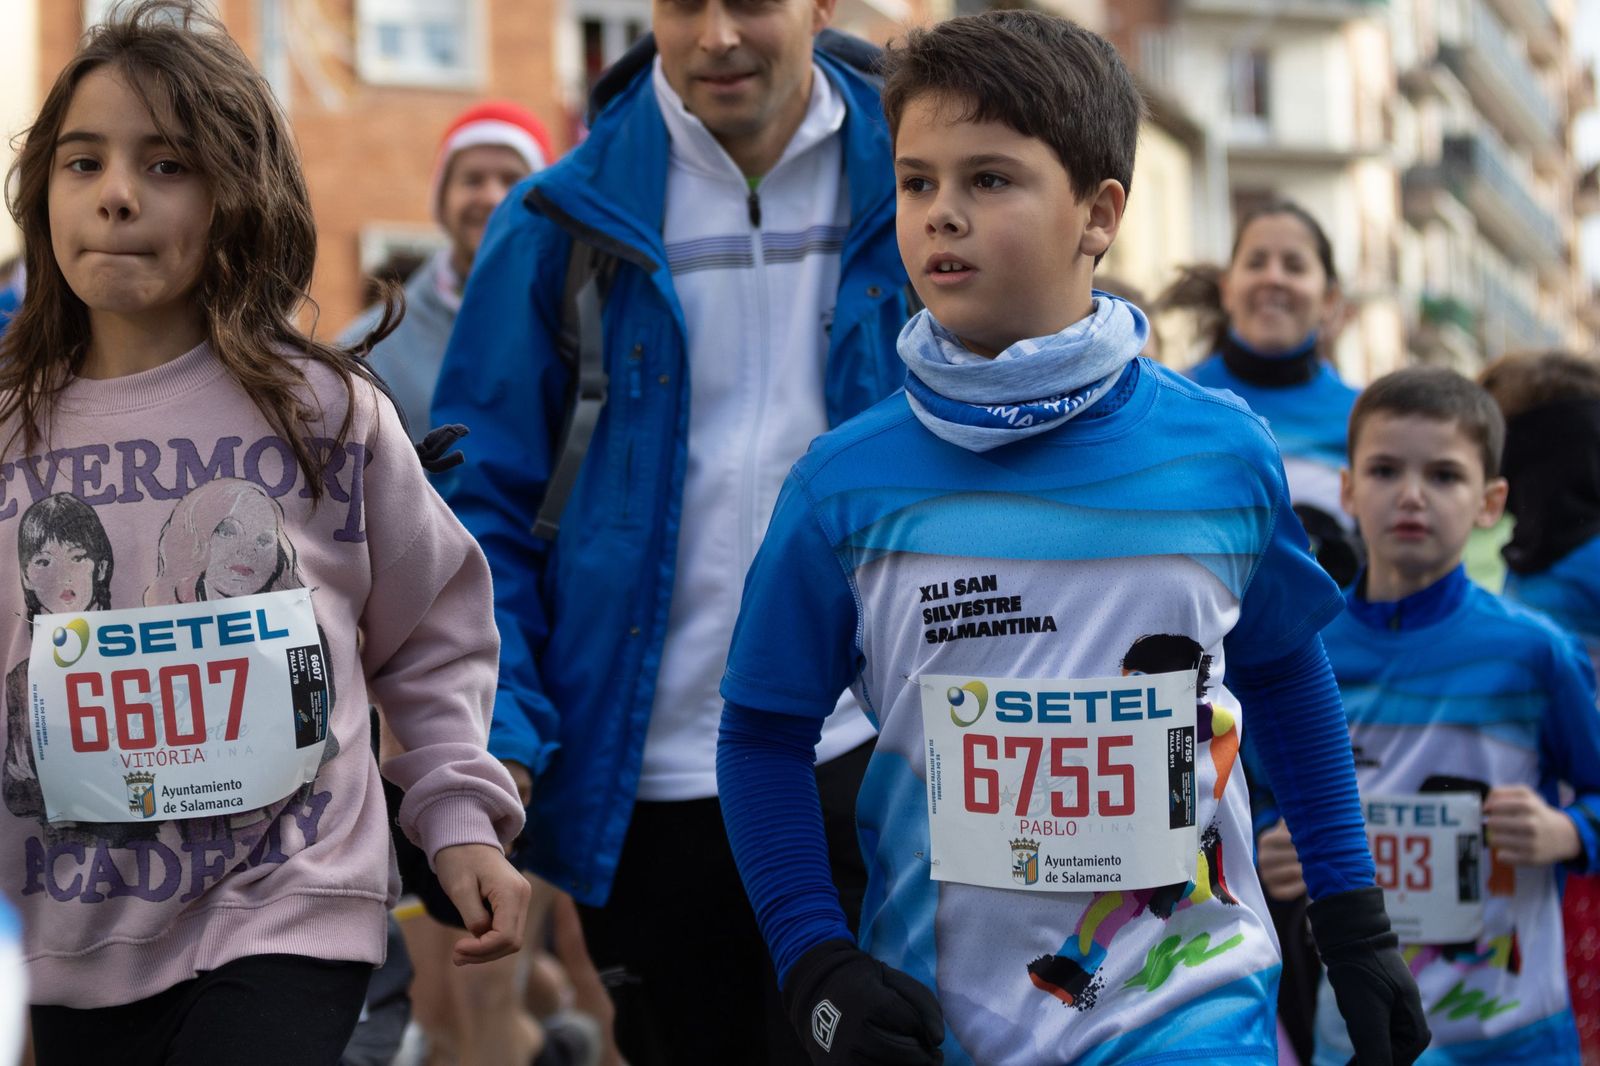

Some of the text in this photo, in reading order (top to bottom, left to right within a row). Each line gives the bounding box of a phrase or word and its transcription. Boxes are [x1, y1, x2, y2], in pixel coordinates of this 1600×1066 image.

[920, 575, 997, 603] XLI SAN
[923, 596, 1022, 625] SILVESTRE
[97, 608, 289, 658] SETEL
[925, 616, 1057, 644] SALMANTINA
[289, 650, 298, 673] TALLA
[297, 649, 305, 672] TALLA:
[310, 654, 322, 681] 6607
[65, 657, 249, 753] 6607
[995, 687, 1172, 724] SETEL
[120, 748, 205, 769] VITÓRIA
[963, 733, 1135, 818] 6755
[161, 779, 242, 799] Ayuntamiento
[163, 797, 243, 814] de Salamanca
[1367, 803, 1460, 827] ETEL
[1020, 819, 1077, 836] PABLO
[1045, 854, 1122, 869] Ayuntamiento
[1372, 833, 1433, 892] 93
[1045, 871, 1122, 883] de Salamanca
